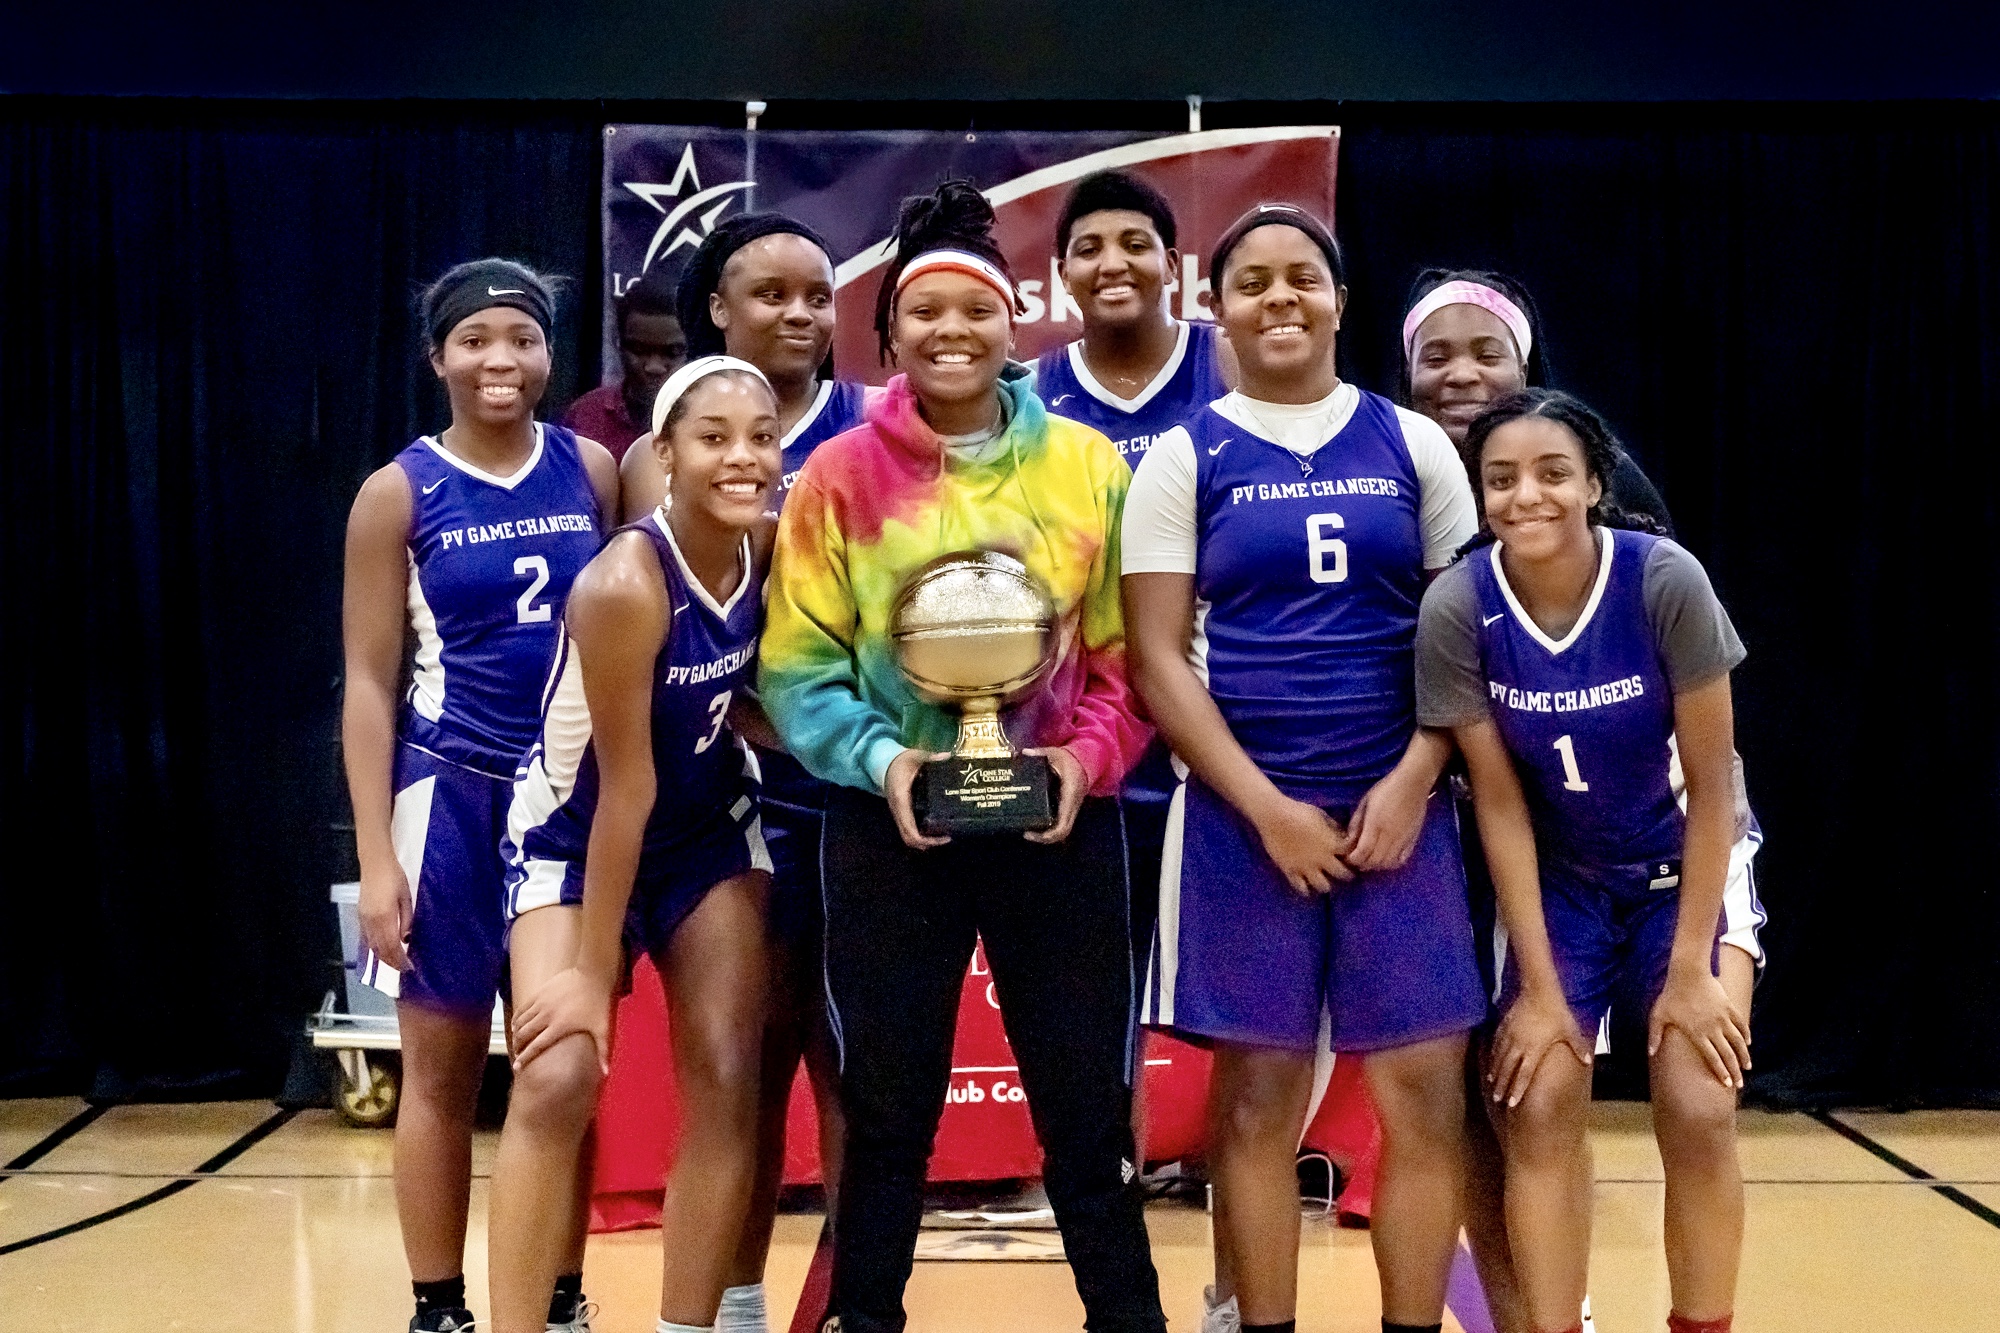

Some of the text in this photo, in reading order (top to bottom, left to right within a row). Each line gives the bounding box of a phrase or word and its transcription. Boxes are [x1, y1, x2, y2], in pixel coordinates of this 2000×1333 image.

[1232, 477, 1399, 505] PV GAME CHANGERS
[440, 514, 592, 550] PV GAME CHANGERS
[1306, 512, 1348, 584] 6
[513, 555, 551, 624] 2
[665, 666, 691, 685] PV
[690, 658, 724, 685] GAME
[1489, 674, 1644, 713] PV GAME CHANGERS
[694, 689, 733, 755] 3
[980, 768, 1014, 777] LONE STAR
[1553, 734, 1589, 792] 1
[971, 787, 986, 795] Sport
[982, 775, 1011, 783] COLLEGE
[986, 793, 1017, 801] Champions
[1659, 864, 1670, 875] S
[991, 1081, 1027, 1103] Co
